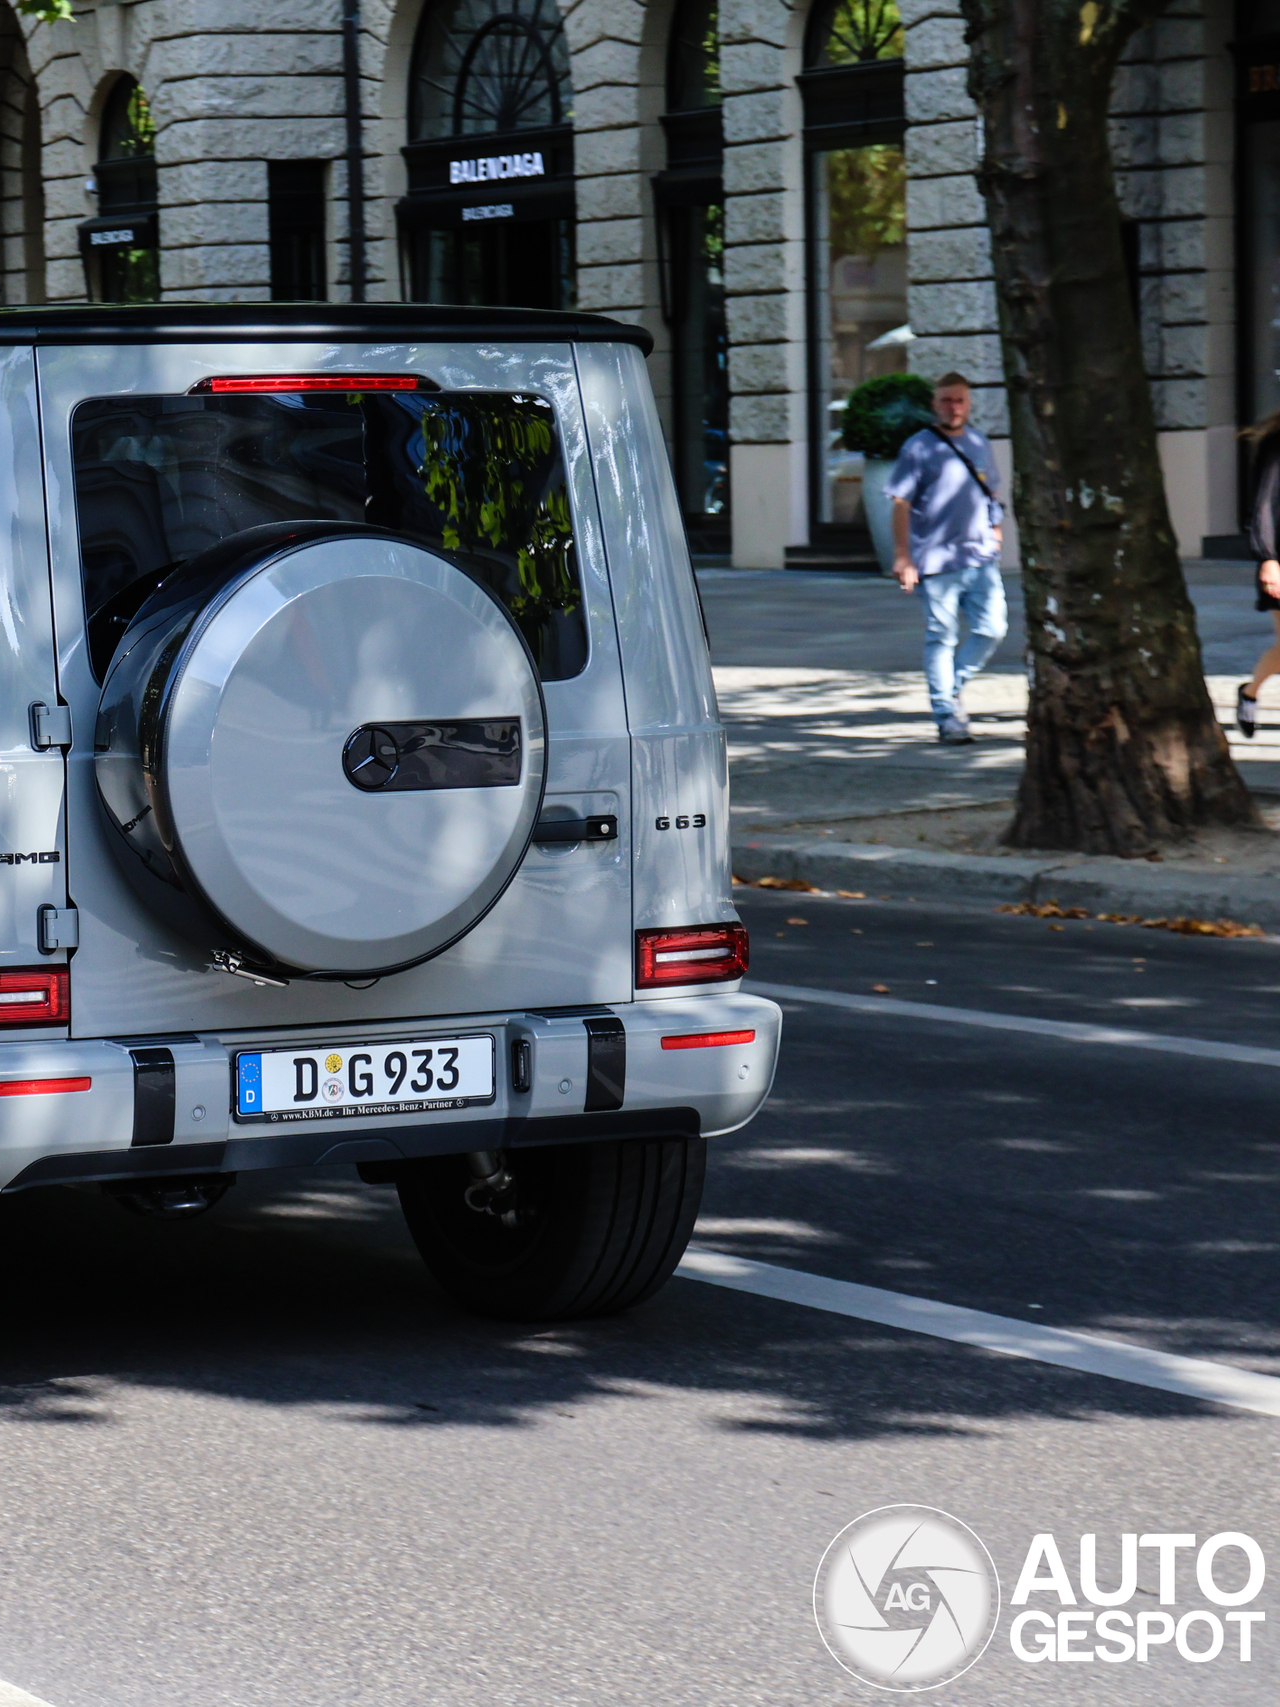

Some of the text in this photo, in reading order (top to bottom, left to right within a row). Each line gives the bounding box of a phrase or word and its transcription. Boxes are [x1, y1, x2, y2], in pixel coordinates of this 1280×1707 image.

[450, 152, 545, 184] BALENCIAGA
[245, 1089, 256, 1103] D
[282, 1107, 334, 1121] www.KBM.de
[341, 1106, 356, 1116] Ihr
